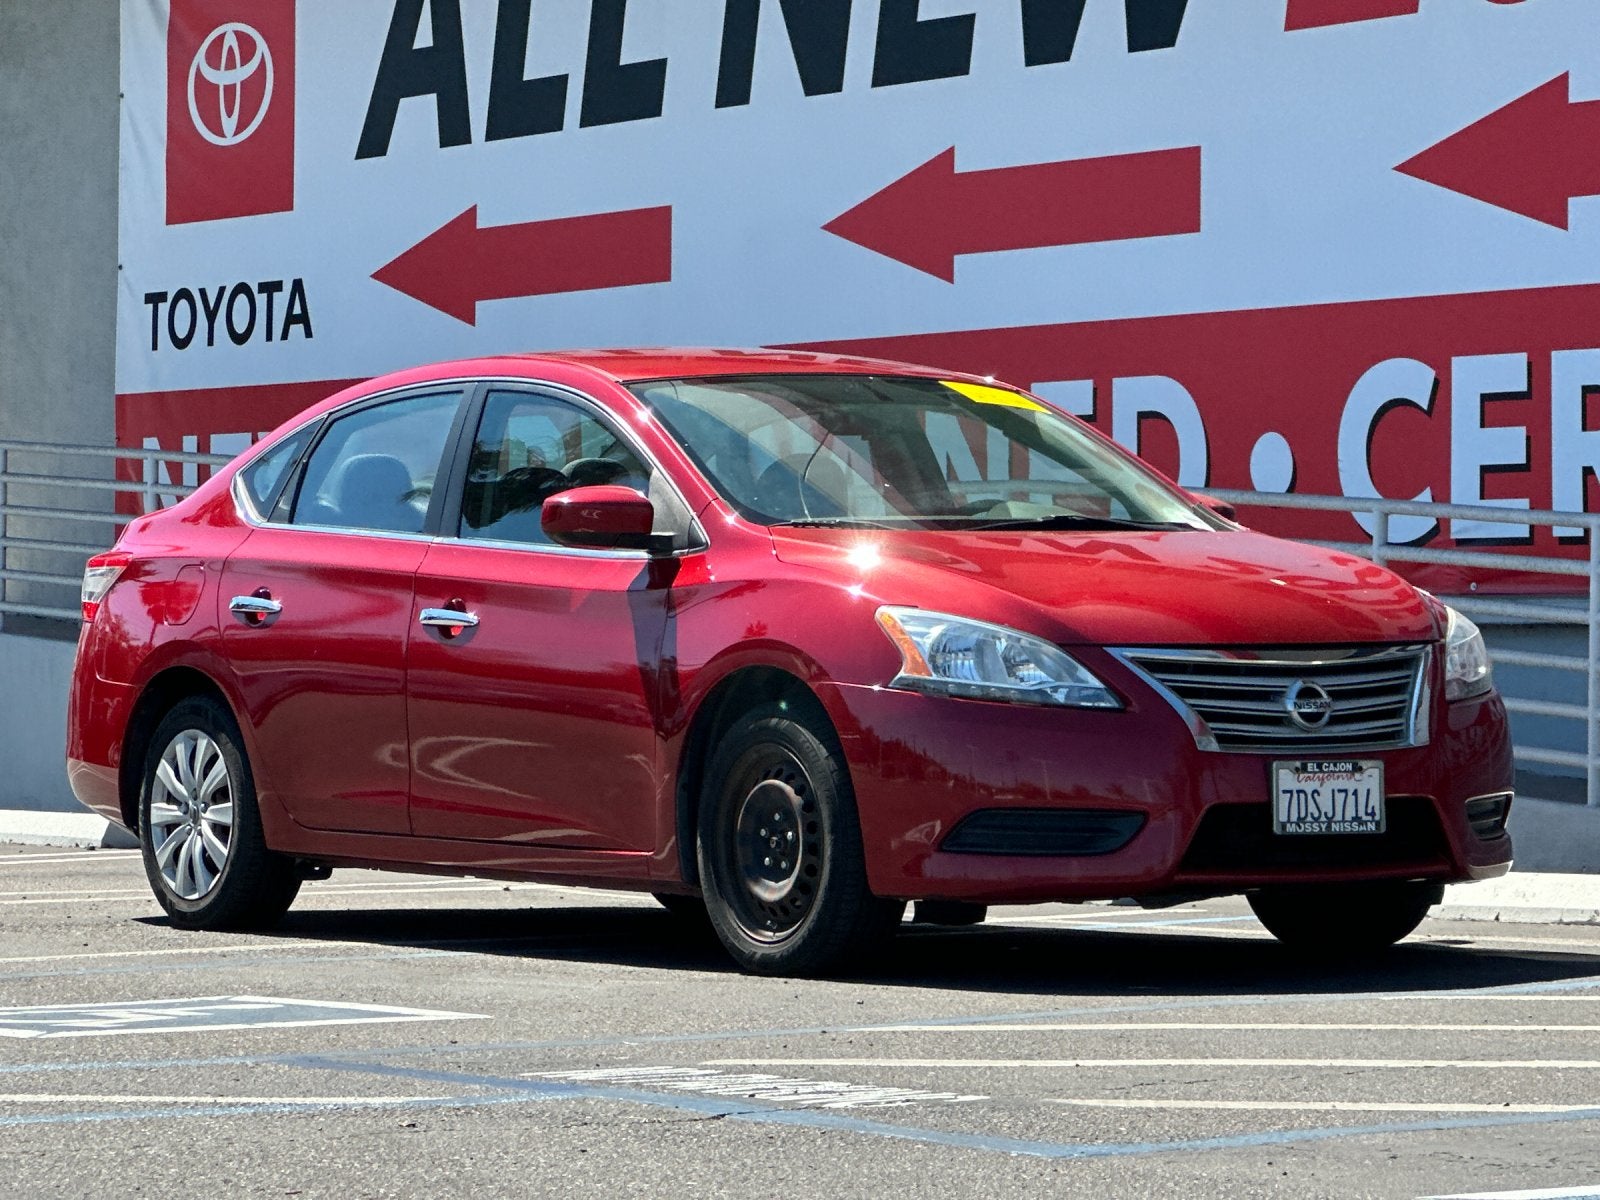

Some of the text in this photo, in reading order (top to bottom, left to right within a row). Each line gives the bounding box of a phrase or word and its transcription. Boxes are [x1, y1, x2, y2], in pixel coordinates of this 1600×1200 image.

[144, 278, 313, 351] TOYOTA
[1293, 701, 1331, 710] NISSAN
[1307, 762, 1353, 772] EL CAJON
[1281, 788, 1377, 822] 7DSJ714
[1286, 821, 1376, 833] MOSSY NISSAN
